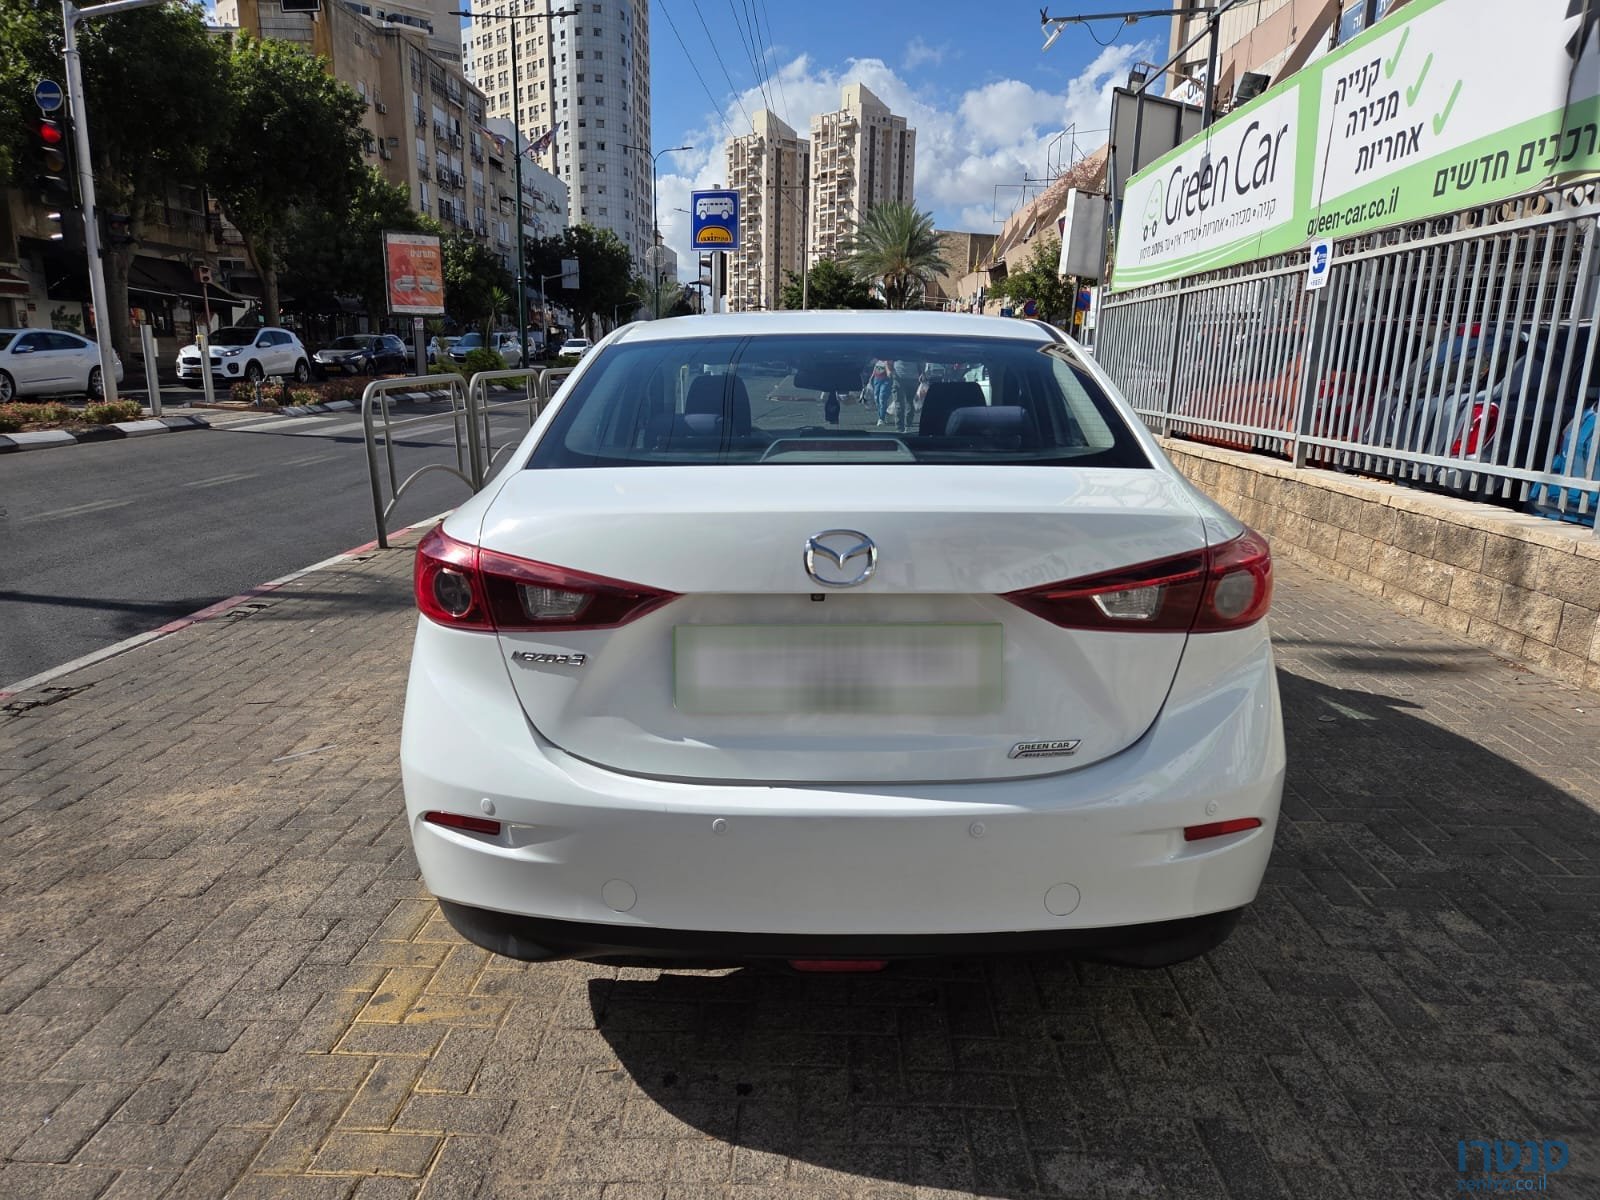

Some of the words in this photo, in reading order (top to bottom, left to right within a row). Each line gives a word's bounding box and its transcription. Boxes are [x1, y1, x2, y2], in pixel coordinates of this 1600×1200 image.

[1335, 57, 1381, 105] קנייה
[1346, 90, 1399, 138] מכירה
[1355, 122, 1424, 174] אחריות
[1165, 156, 1229, 225] Green
[1235, 121, 1288, 195] Car
[1433, 150, 1509, 197] חדשים
